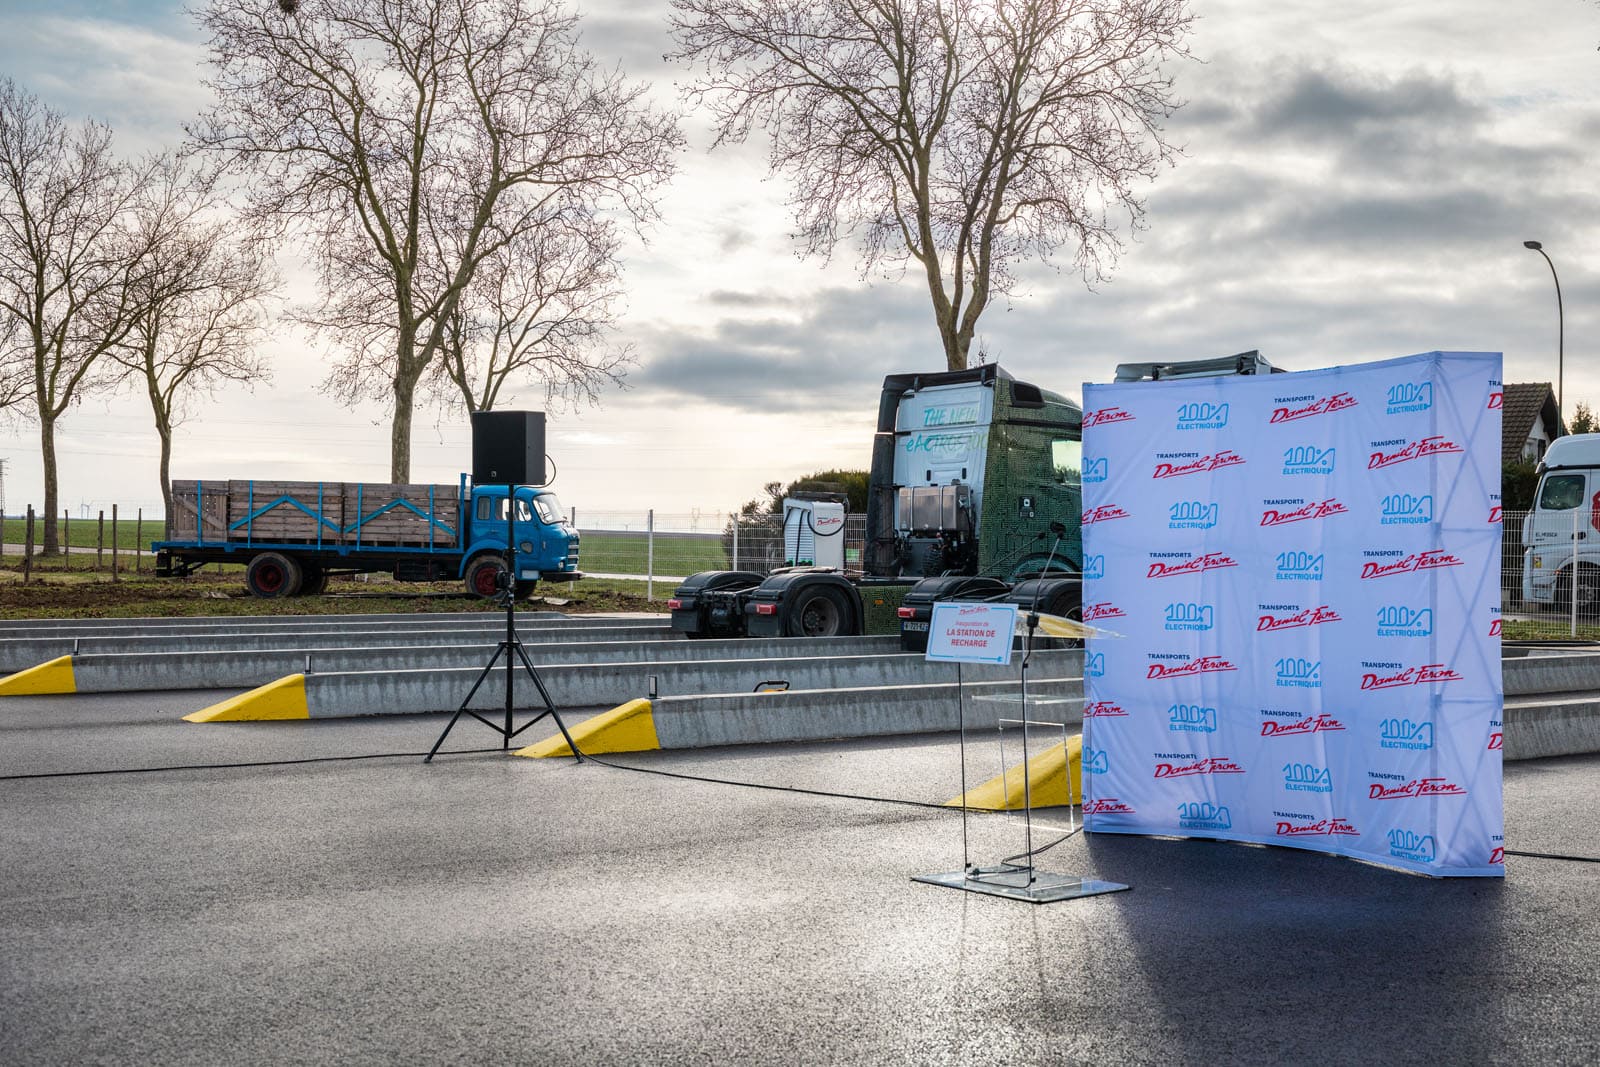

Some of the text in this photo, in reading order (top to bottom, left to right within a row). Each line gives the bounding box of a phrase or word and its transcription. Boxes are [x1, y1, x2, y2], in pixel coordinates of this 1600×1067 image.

[1274, 395, 1315, 404] TRANSPORTS
[1386, 382, 1428, 405] 100%
[924, 407, 945, 425] THE
[1091, 407, 1136, 427] Feron
[1177, 403, 1226, 421] 100%
[1269, 397, 1326, 424] Daniel
[1368, 436, 1464, 469] Daniel Feron
[1371, 439, 1406, 448] TRANSPORTS
[1153, 450, 1246, 479] Daniel Feron
[1284, 446, 1333, 466] 100%
[1091, 504, 1130, 524] Feron
[1260, 502, 1315, 527] Daniel
[1381, 494, 1428, 515] 100%
[1147, 556, 1201, 579] Daniel
[1276, 551, 1323, 571] 100%
[1360, 550, 1464, 579] Daniel Feron
[1091, 603, 1127, 620] Feron
[1256, 610, 1310, 632] Daniel
[1377, 606, 1427, 627] 100%
[946, 628, 996, 638] LA STATION DE
[1165, 623, 1207, 631] ÉLECTRIQE
[950, 638, 988, 648] RECHARGE
[1146, 656, 1237, 680] Daniel Feron
[1275, 658, 1320, 678] 100%
[1361, 661, 1402, 669] TRANSPORTS
[1360, 664, 1464, 690] Daniel Feron
[1093, 701, 1129, 717] Feron
[1261, 709, 1302, 718] TRANSPORTS
[1261, 717, 1313, 737] Daniel
[1380, 719, 1427, 740] 100%
[1154, 759, 1209, 779] Daniel
[1282, 763, 1329, 784] 100%
[1368, 771, 1405, 781] TRANSPORTS
[1369, 778, 1467, 800] Daniel Feron
[1091, 799, 1136, 814] Feron
[1273, 811, 1315, 821] TRANSPORTS
[1276, 820, 1327, 836] Daniel
[1387, 829, 1429, 851] 100%
